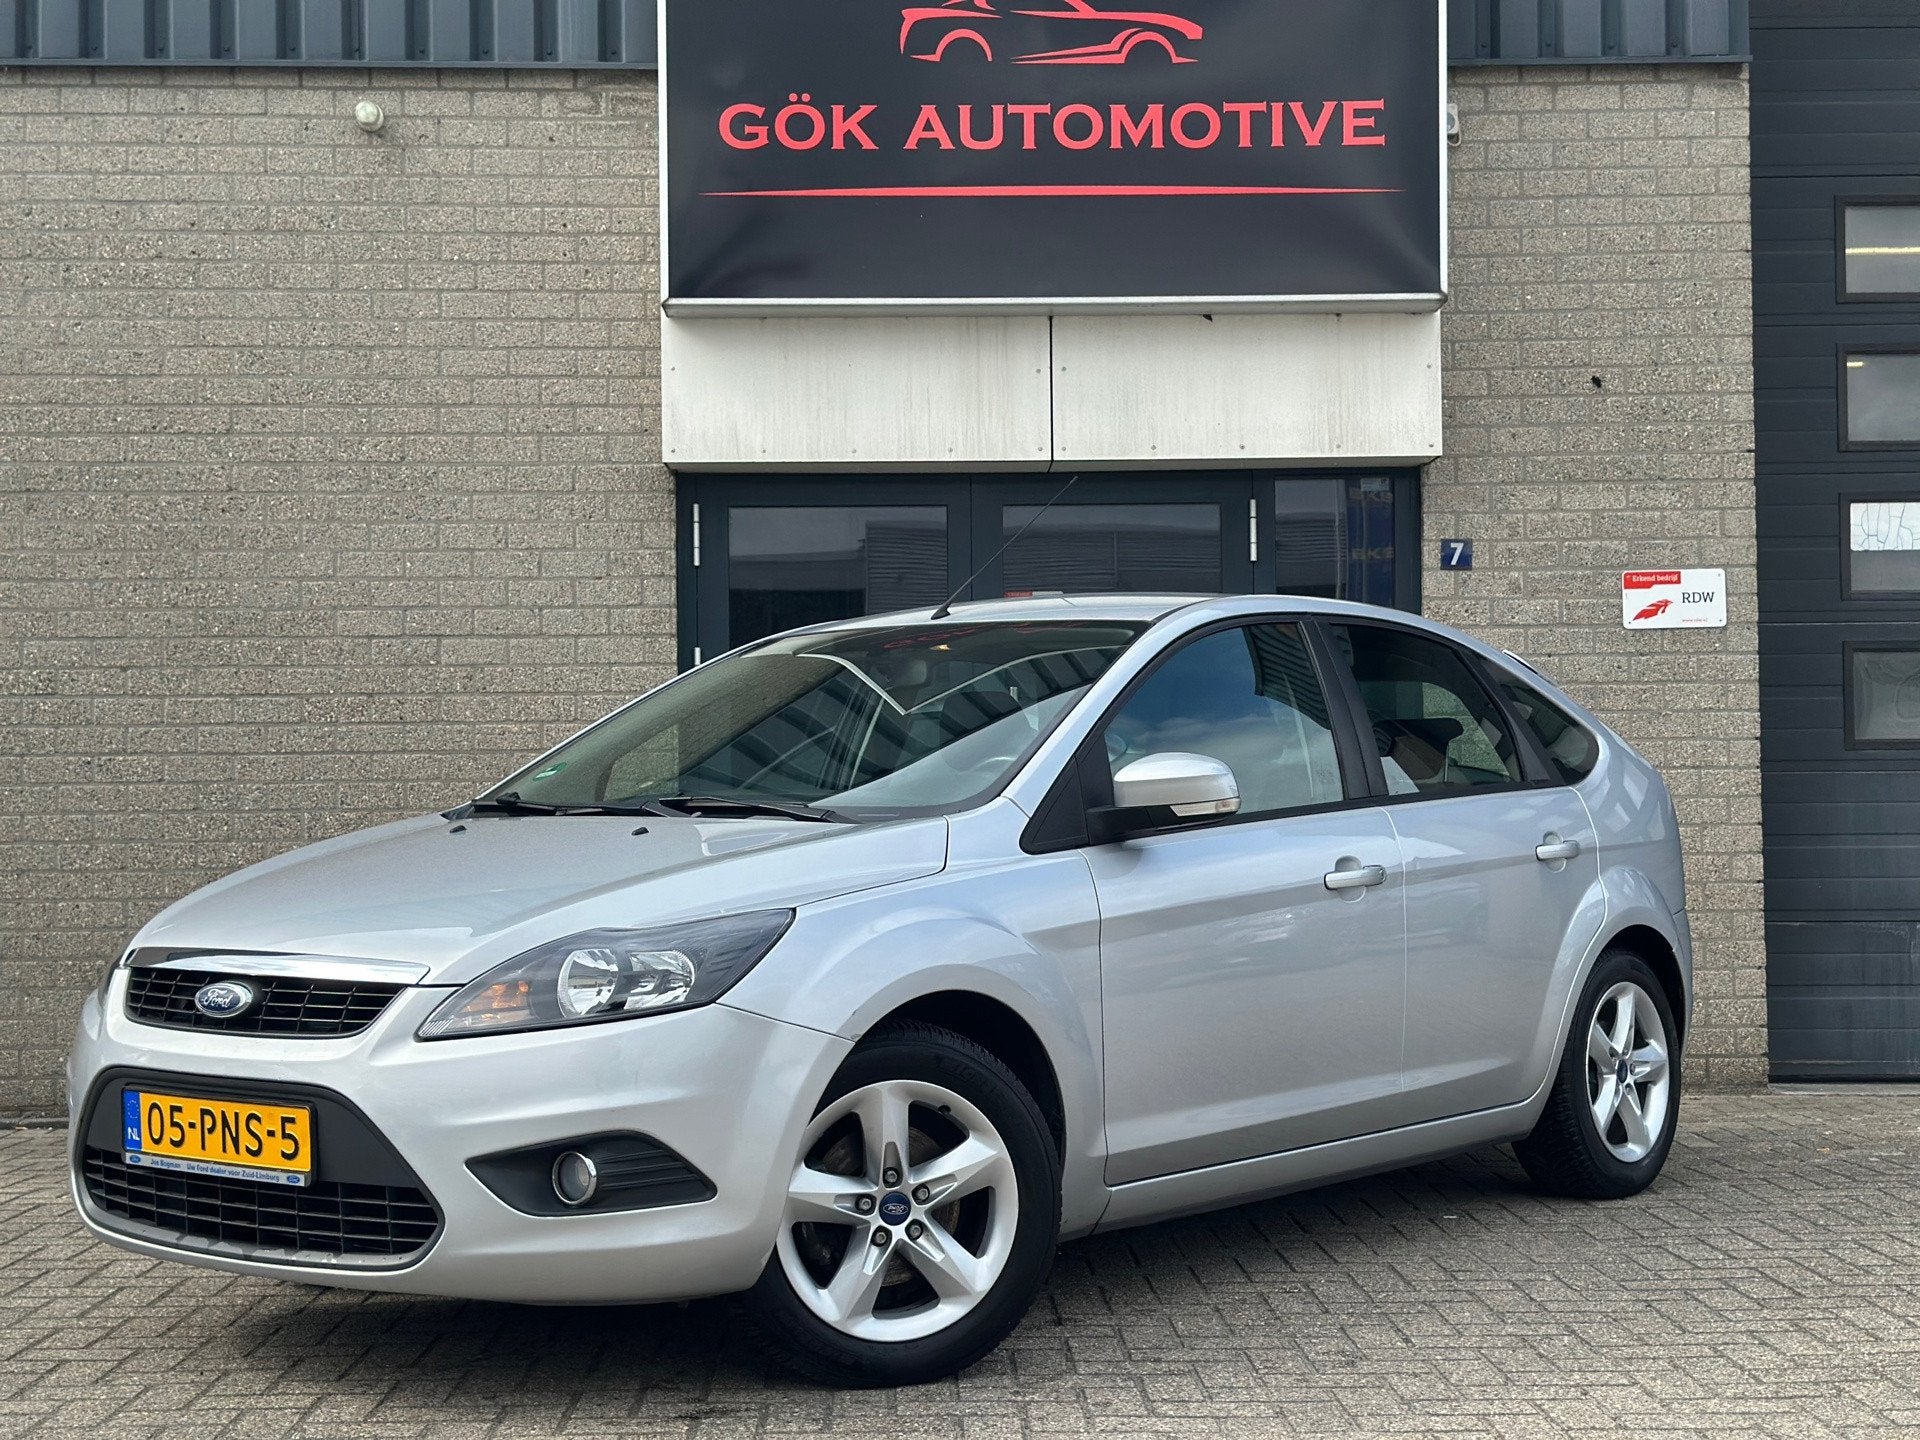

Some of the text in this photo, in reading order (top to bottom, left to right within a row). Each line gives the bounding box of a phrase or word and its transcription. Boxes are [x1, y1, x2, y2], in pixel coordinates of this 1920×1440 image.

[718, 92, 1386, 150] GÖK AUTOMOTIVE
[1450, 542, 1464, 565] 7
[1682, 591, 1715, 603] RDW
[200, 988, 234, 1008] Ford
[127, 1126, 141, 1141] NL
[147, 1101, 300, 1161] 05-PNS-5
[196, 1164, 209, 1172] Ford
